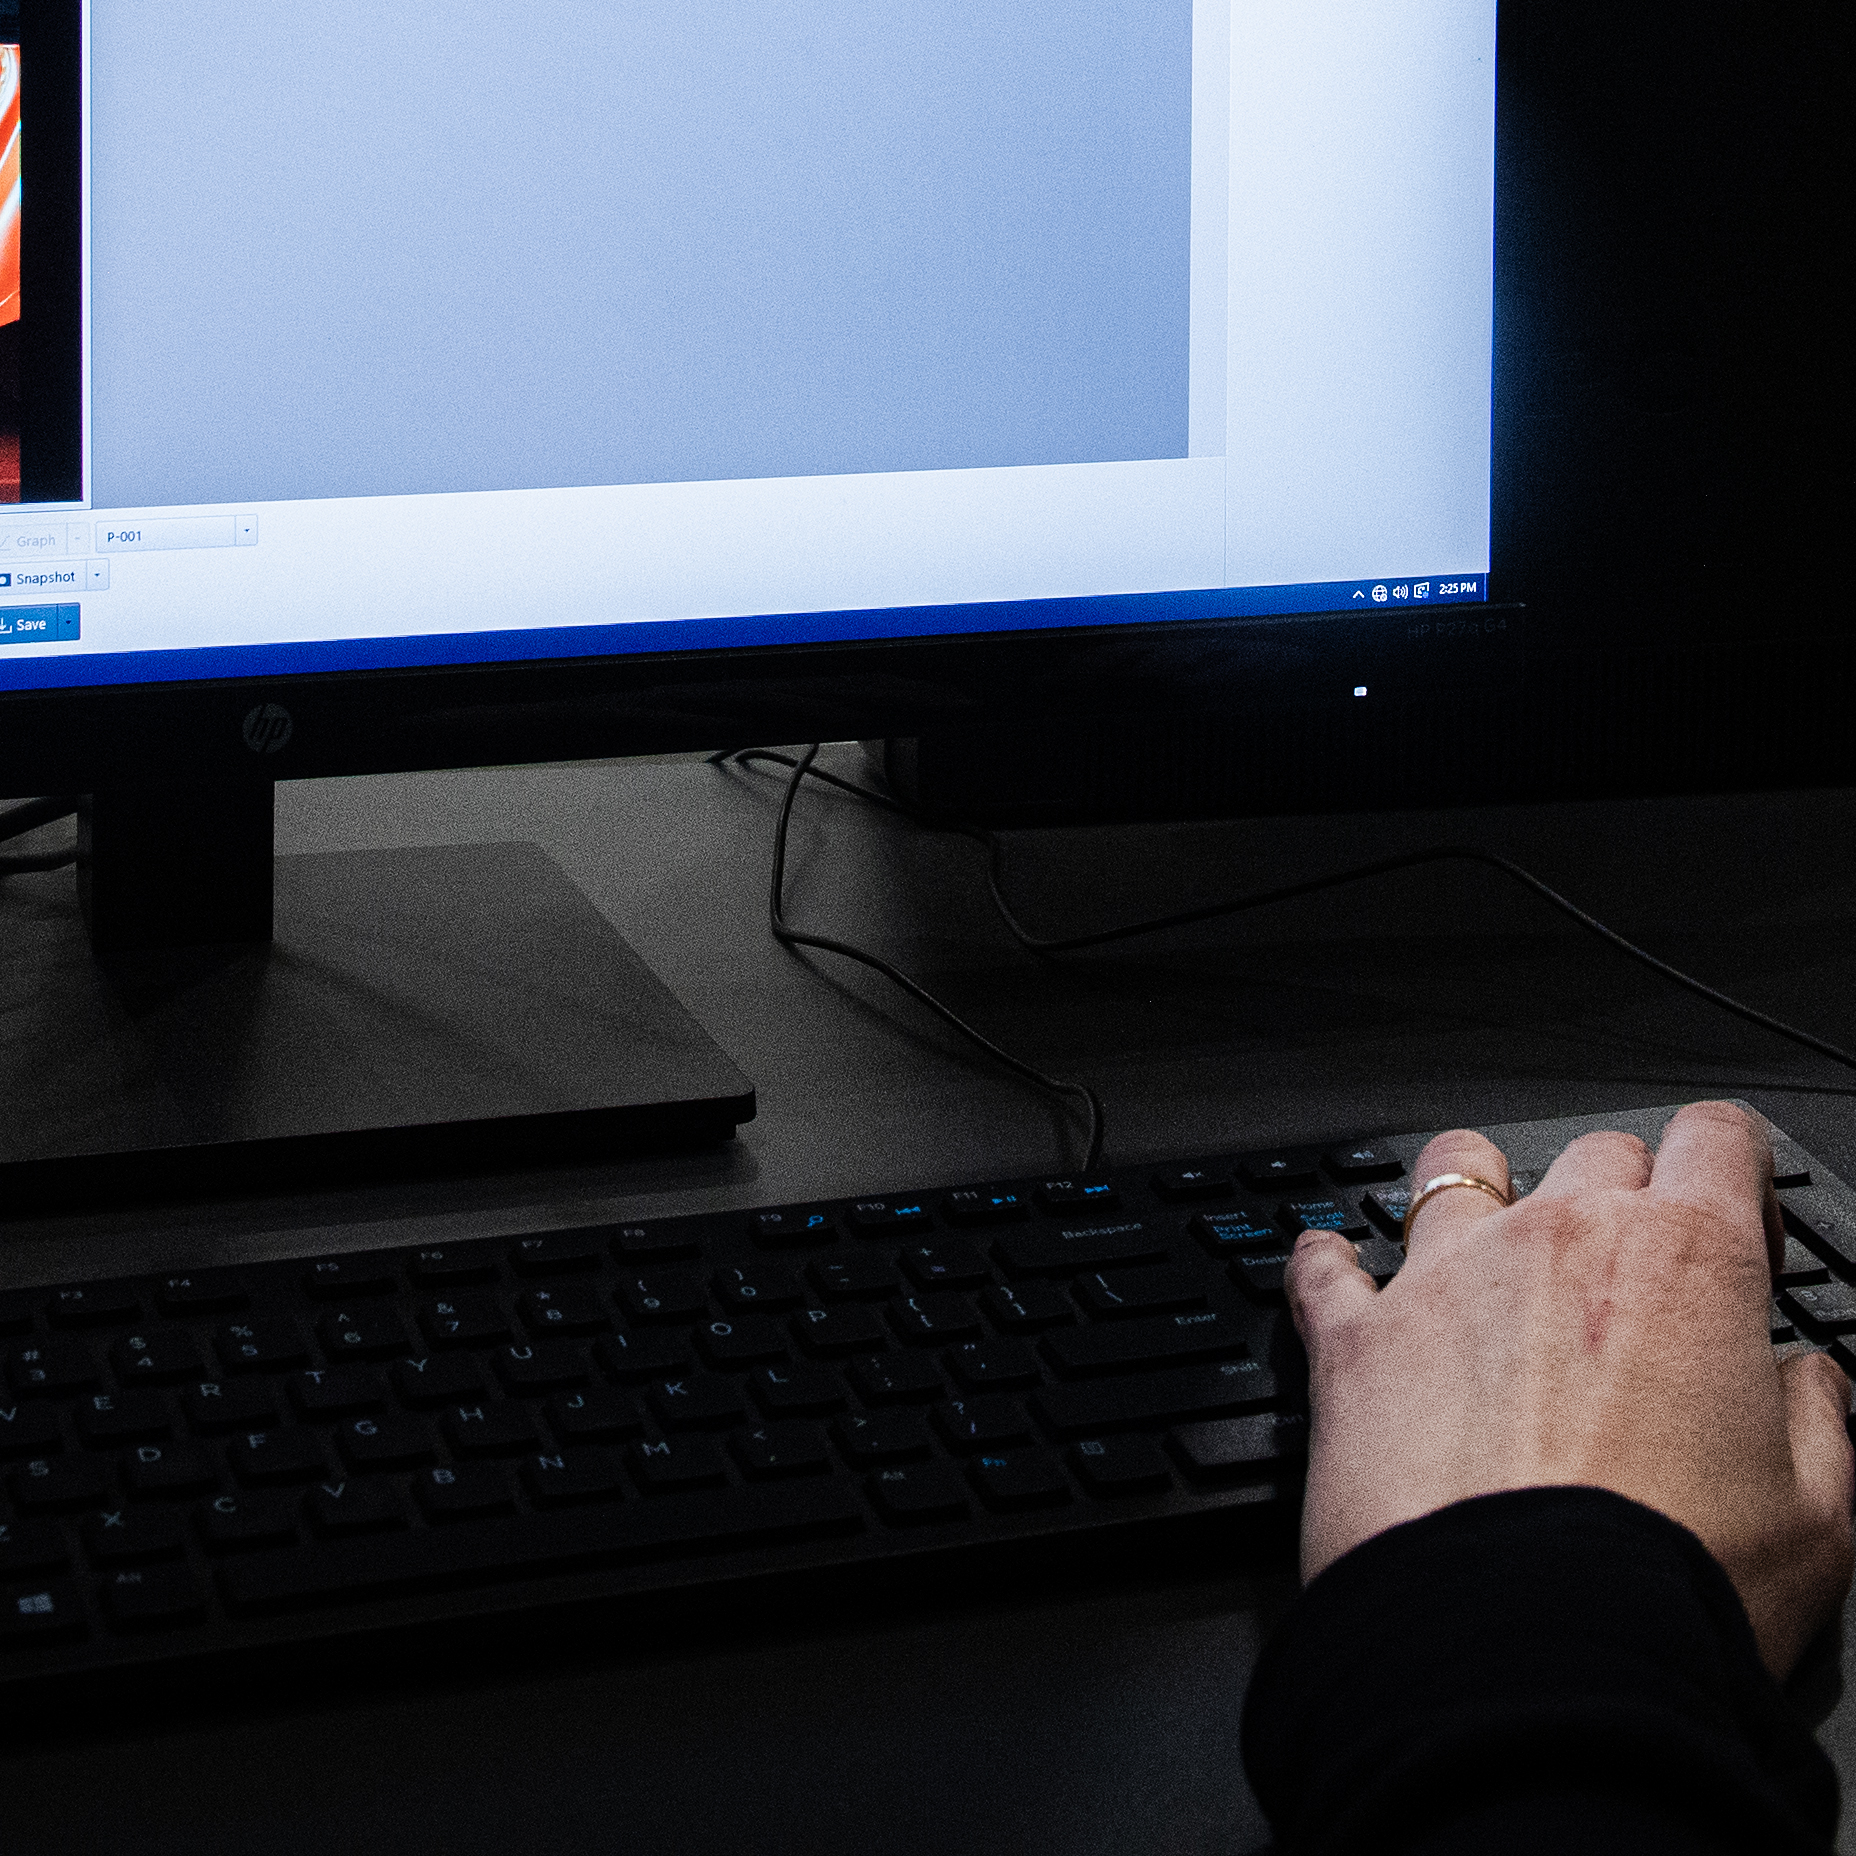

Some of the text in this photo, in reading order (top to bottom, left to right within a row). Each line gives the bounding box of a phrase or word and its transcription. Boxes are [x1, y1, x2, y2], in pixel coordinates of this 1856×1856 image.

[107, 530, 142, 542] P-001
[17, 570, 75, 586] Snapshot
[1439, 582, 1476, 594] 2:25 PM
[17, 617, 46, 631] Save
[1202, 1209, 1247, 1225] Insert
[1061, 1221, 1143, 1239] Backspace
[1174, 1312, 1218, 1327] Enter
[458, 1405, 484, 1423] H
[354, 1419, 378, 1436] G
[642, 1440, 671, 1457] M
